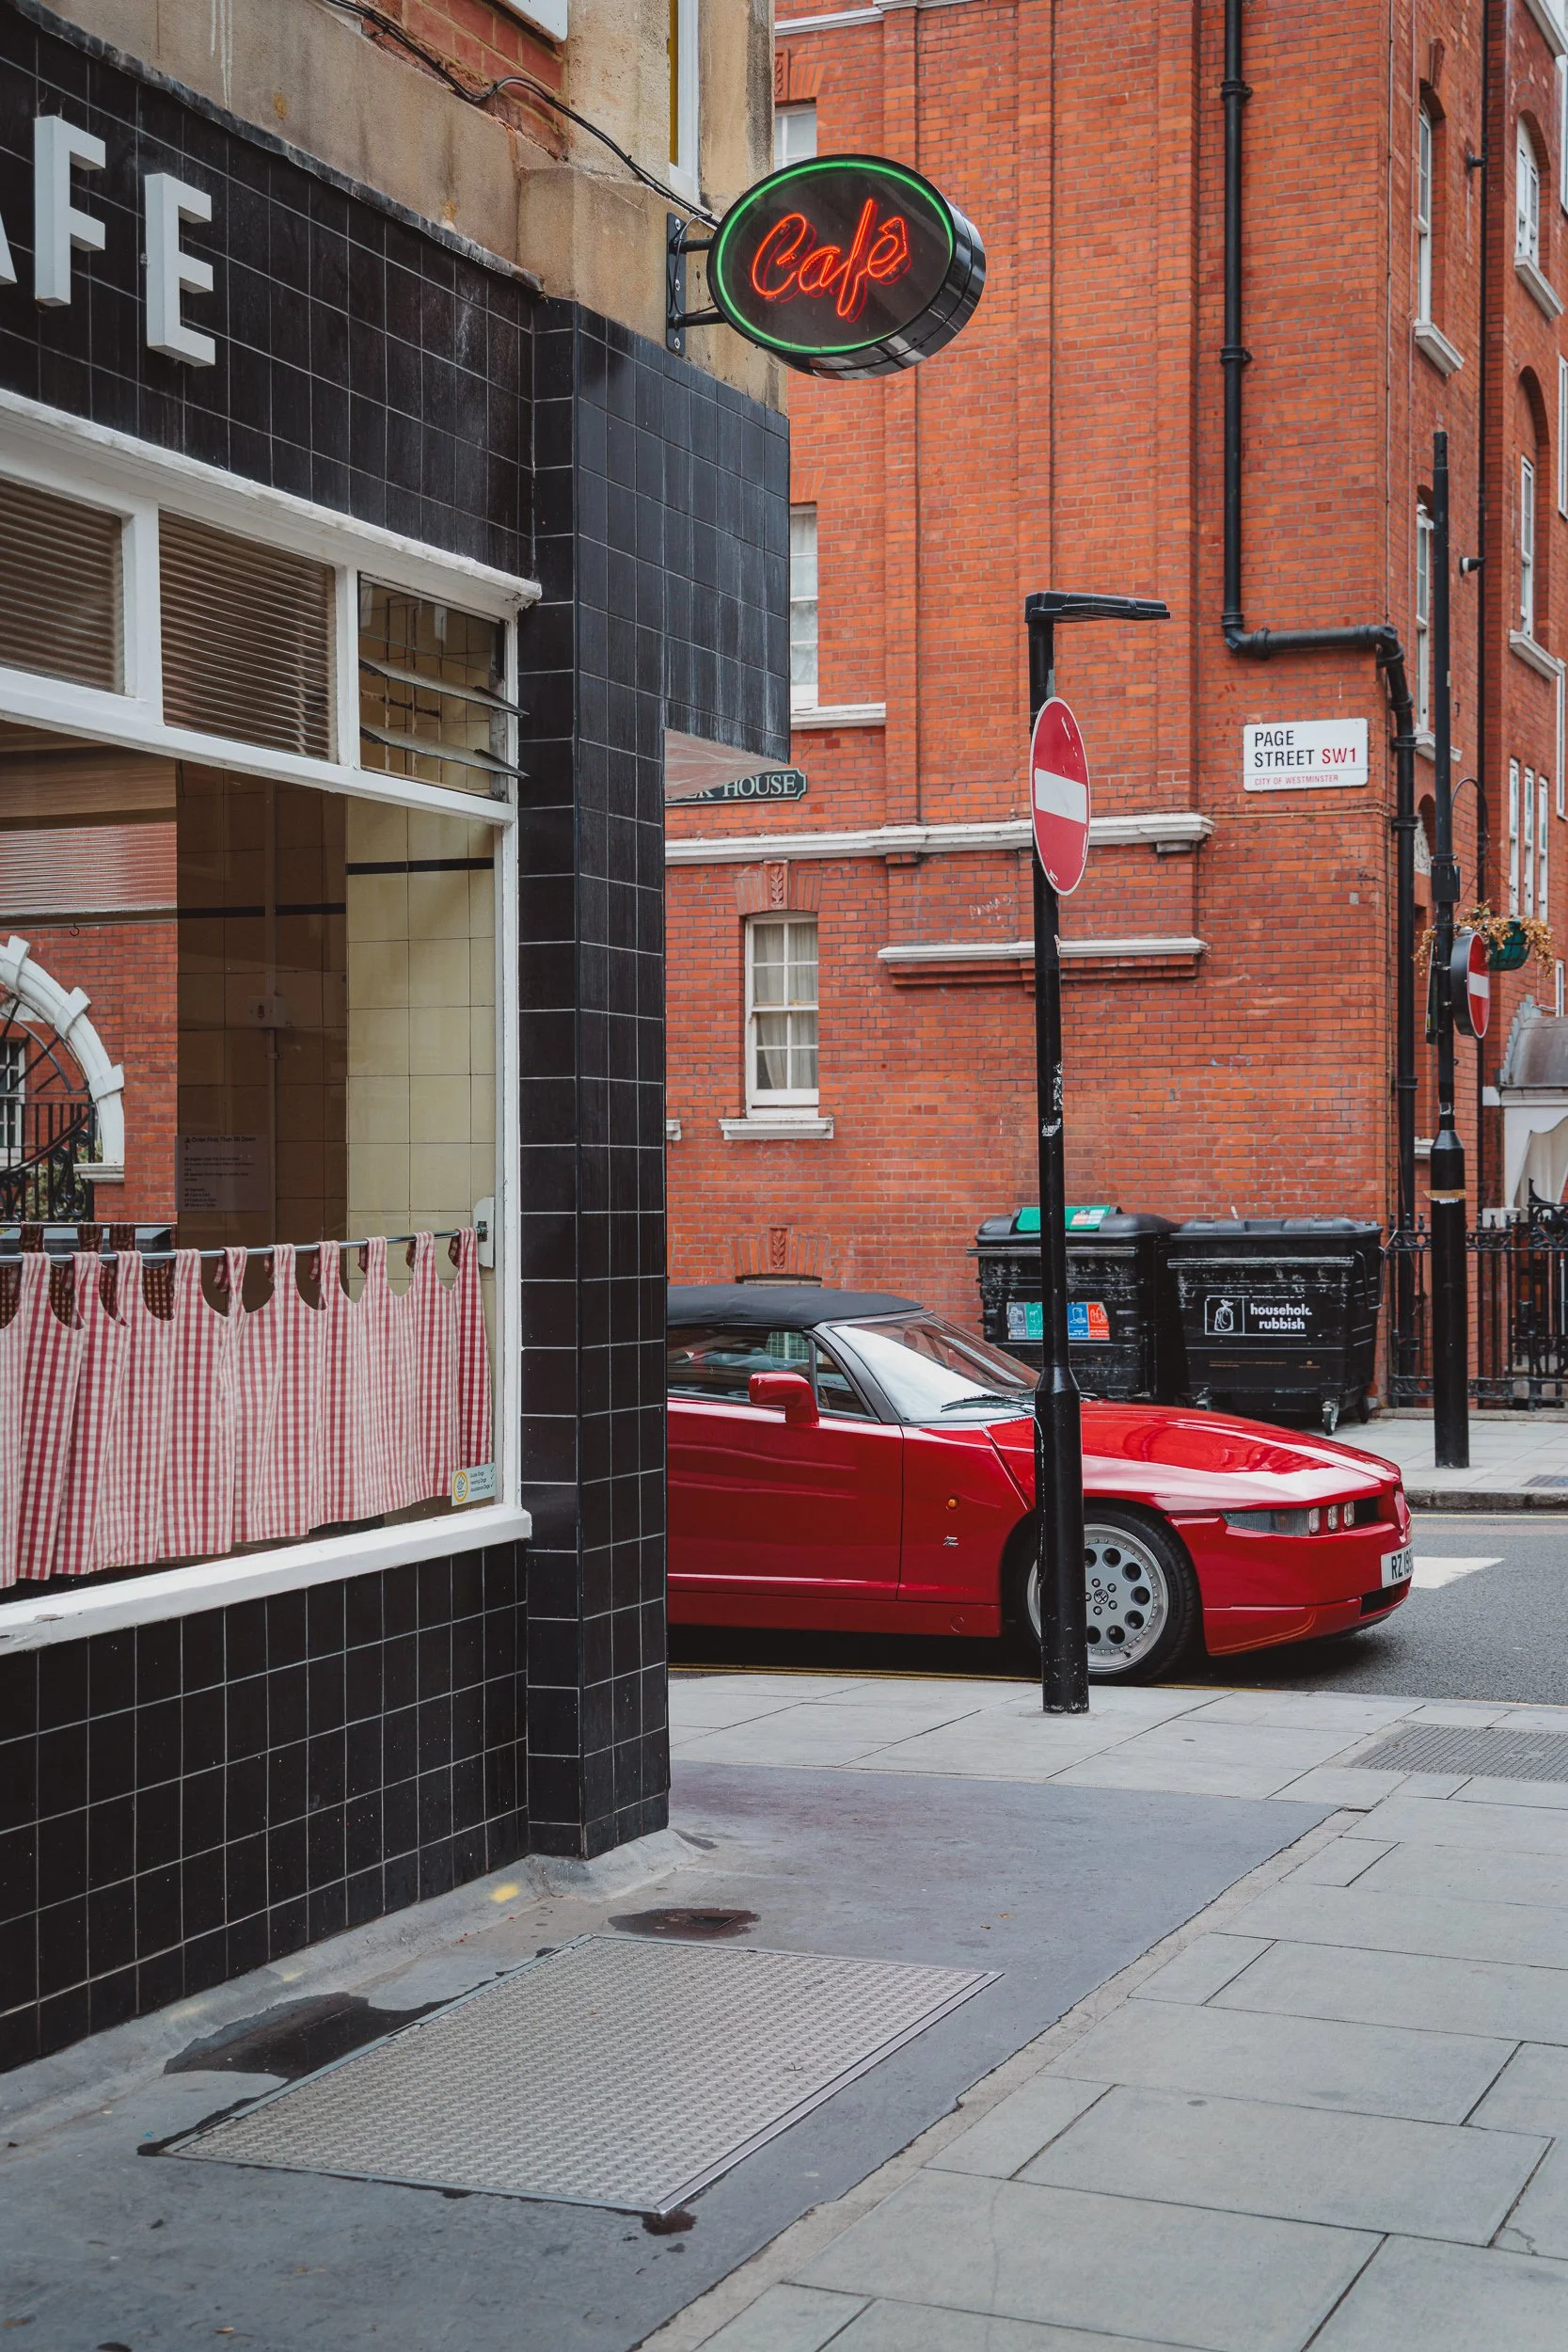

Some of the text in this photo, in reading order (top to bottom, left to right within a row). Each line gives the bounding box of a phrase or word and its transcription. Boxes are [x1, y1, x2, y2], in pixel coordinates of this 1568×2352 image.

[0, 115, 215, 367] FE
[1255, 730, 1294, 748] PAGE
[1255, 747, 1356, 768] STREET SW1
[722, 773, 798, 798] HOUSE
[1255, 778, 1271, 787] CITY
[1285, 774, 1339, 785] WESTMINSTER
[1259, 1317, 1306, 1330] rubbish
